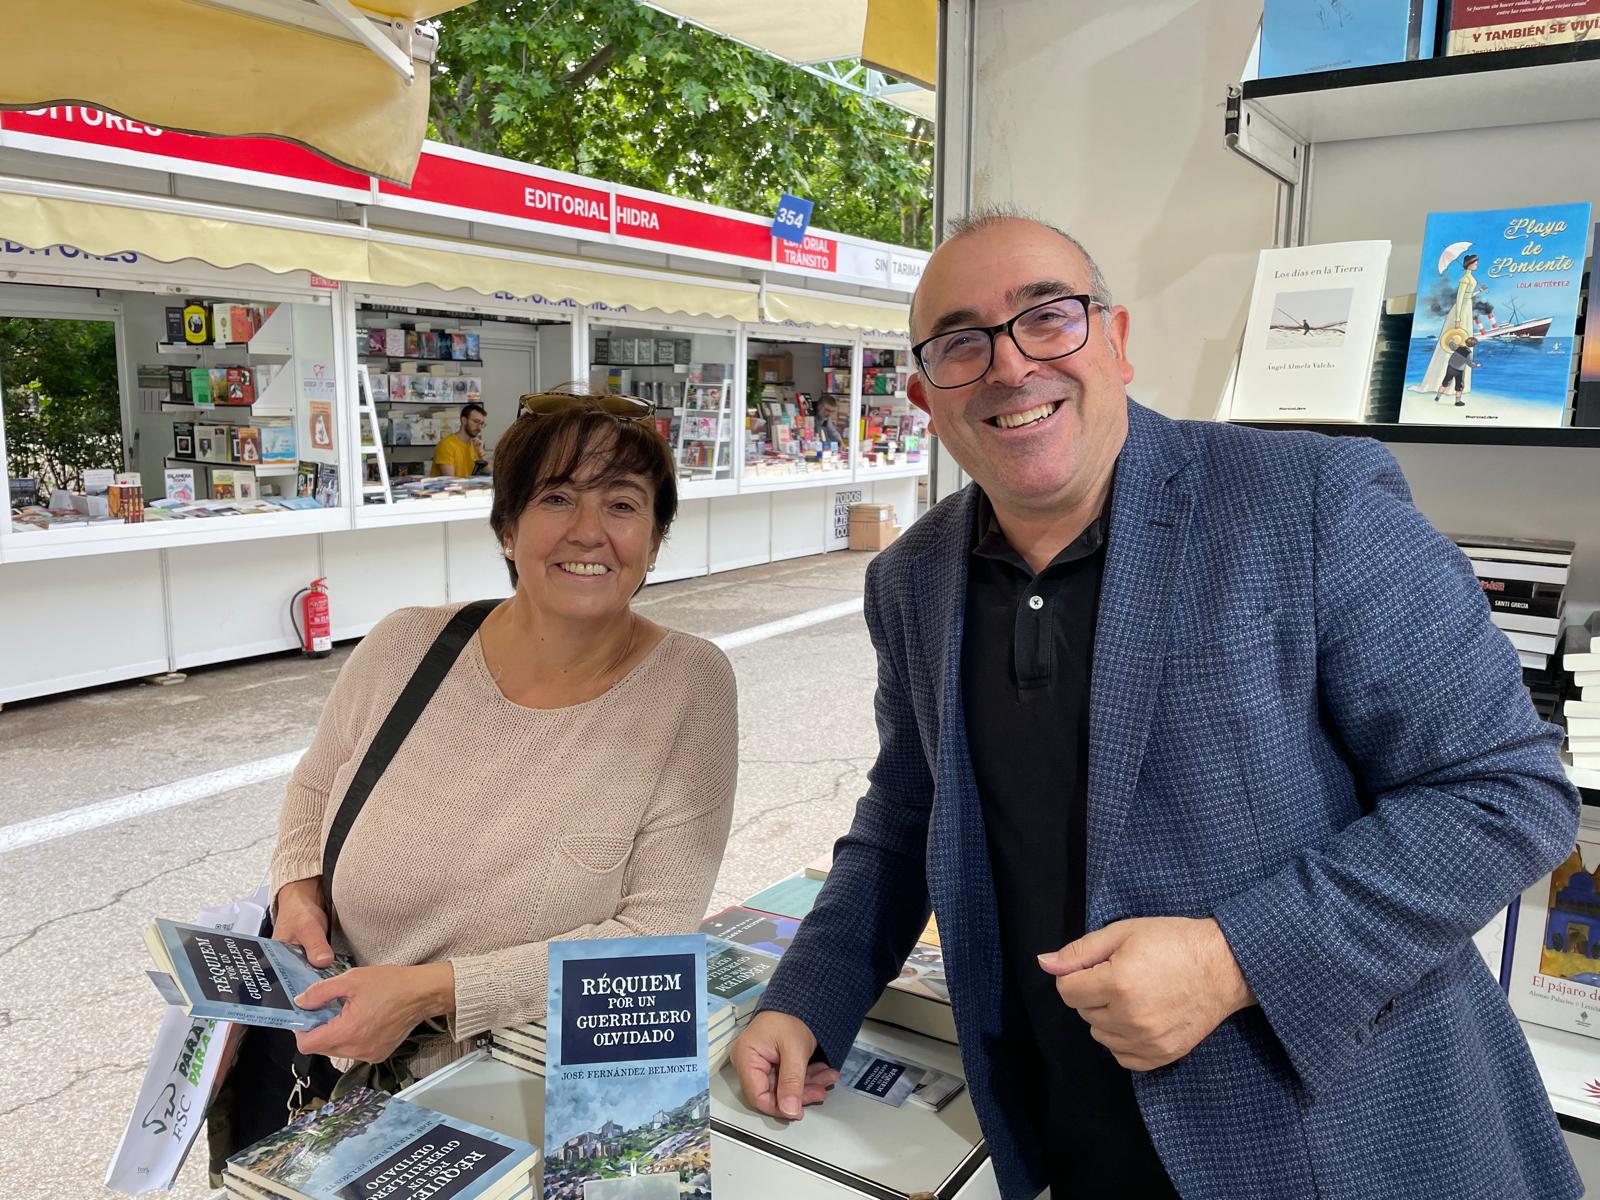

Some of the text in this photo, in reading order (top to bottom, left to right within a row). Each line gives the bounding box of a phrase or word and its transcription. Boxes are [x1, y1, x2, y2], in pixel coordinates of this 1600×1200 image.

[1472, 33, 1482, 43] Y
[1484, 25, 1545, 41] TAMBIÉN
[1549, 24, 1566, 34] SE
[524, 187, 660, 230] EDITORIAL HIDRA
[777, 207, 804, 229] 354
[1503, 218, 1568, 240] Playa
[1521, 240, 1543, 256] de
[875, 258, 921, 277] SIN TARIMA
[1274, 270, 1290, 279] Los
[1291, 268, 1309, 277] días
[1324, 267, 1332, 275] la
[1334, 265, 1363, 274] Tierra
[1487, 255, 1574, 278] Poniente
[1517, 281, 1531, 289] LOLA
[1494, 599, 1510, 607] SANTI
[195, 937, 233, 994] RÉQUIEM
[219, 952, 239, 981] POR UN
[224, 938, 262, 1000] GUERRILLERO
[243, 948, 272, 992] OLVIDADO
[581, 972, 682, 996] RÉQUIEM
[1532, 975, 1545, 988] El
[1547, 981, 1586, 998] pájaro
[608, 995, 656, 1009] POR UN
[576, 1009, 691, 1029] GUERRILLERO
[593, 1029, 675, 1047] OLVIDADO
[179, 1025, 205, 1078] PARA
[187, 1034, 211, 1087] PARA
[588, 1067, 646, 1079] FERNÁNDEZ
[648, 1064, 698, 1075] BELMONTE
[172, 1094, 192, 1144] FSC
[365, 1144, 435, 1190] OLVIDADO
[406, 1150, 487, 1200] RÉQUIE
[407, 1160, 451, 1191] POR UN
